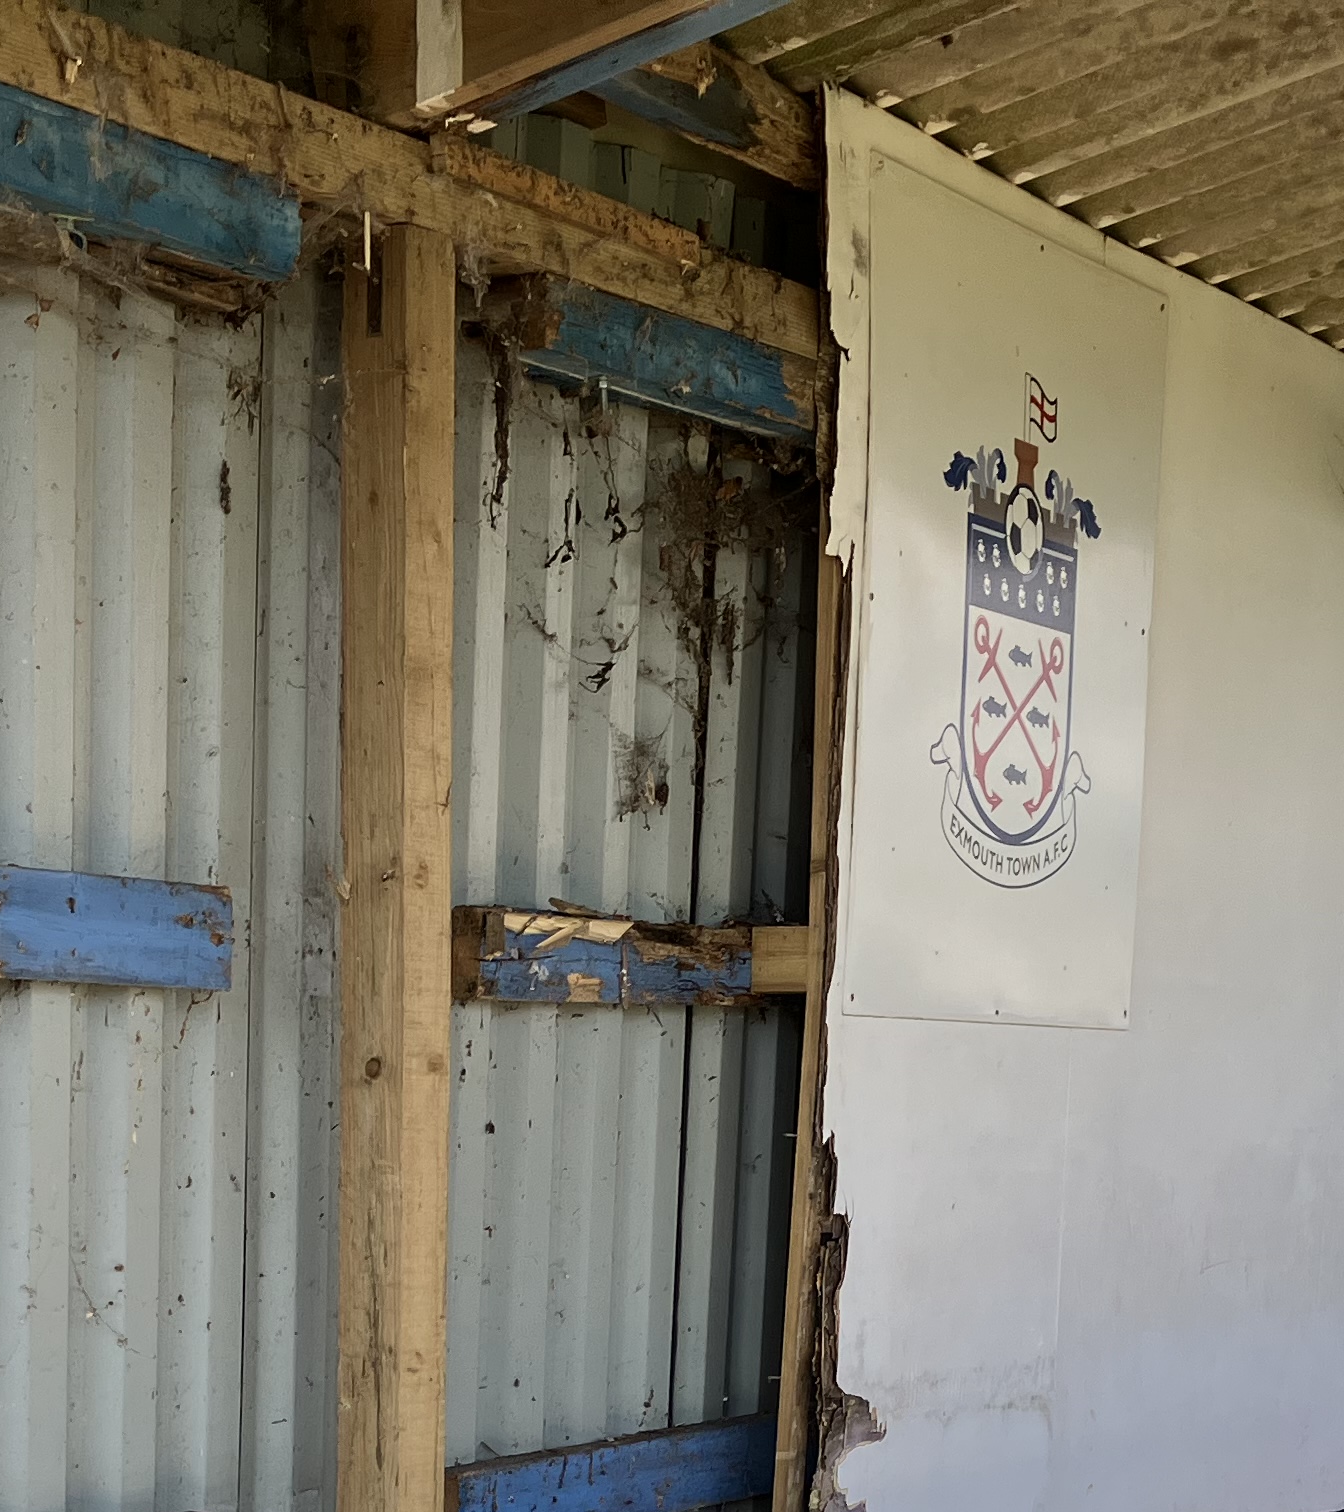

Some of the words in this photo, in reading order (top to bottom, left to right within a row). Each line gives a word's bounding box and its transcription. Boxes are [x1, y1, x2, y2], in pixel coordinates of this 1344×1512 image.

[949, 813, 1003, 874] EXMOUTH
[1006, 853, 1042, 877] TOWN
[1043, 833, 1069, 868] A.F.C
